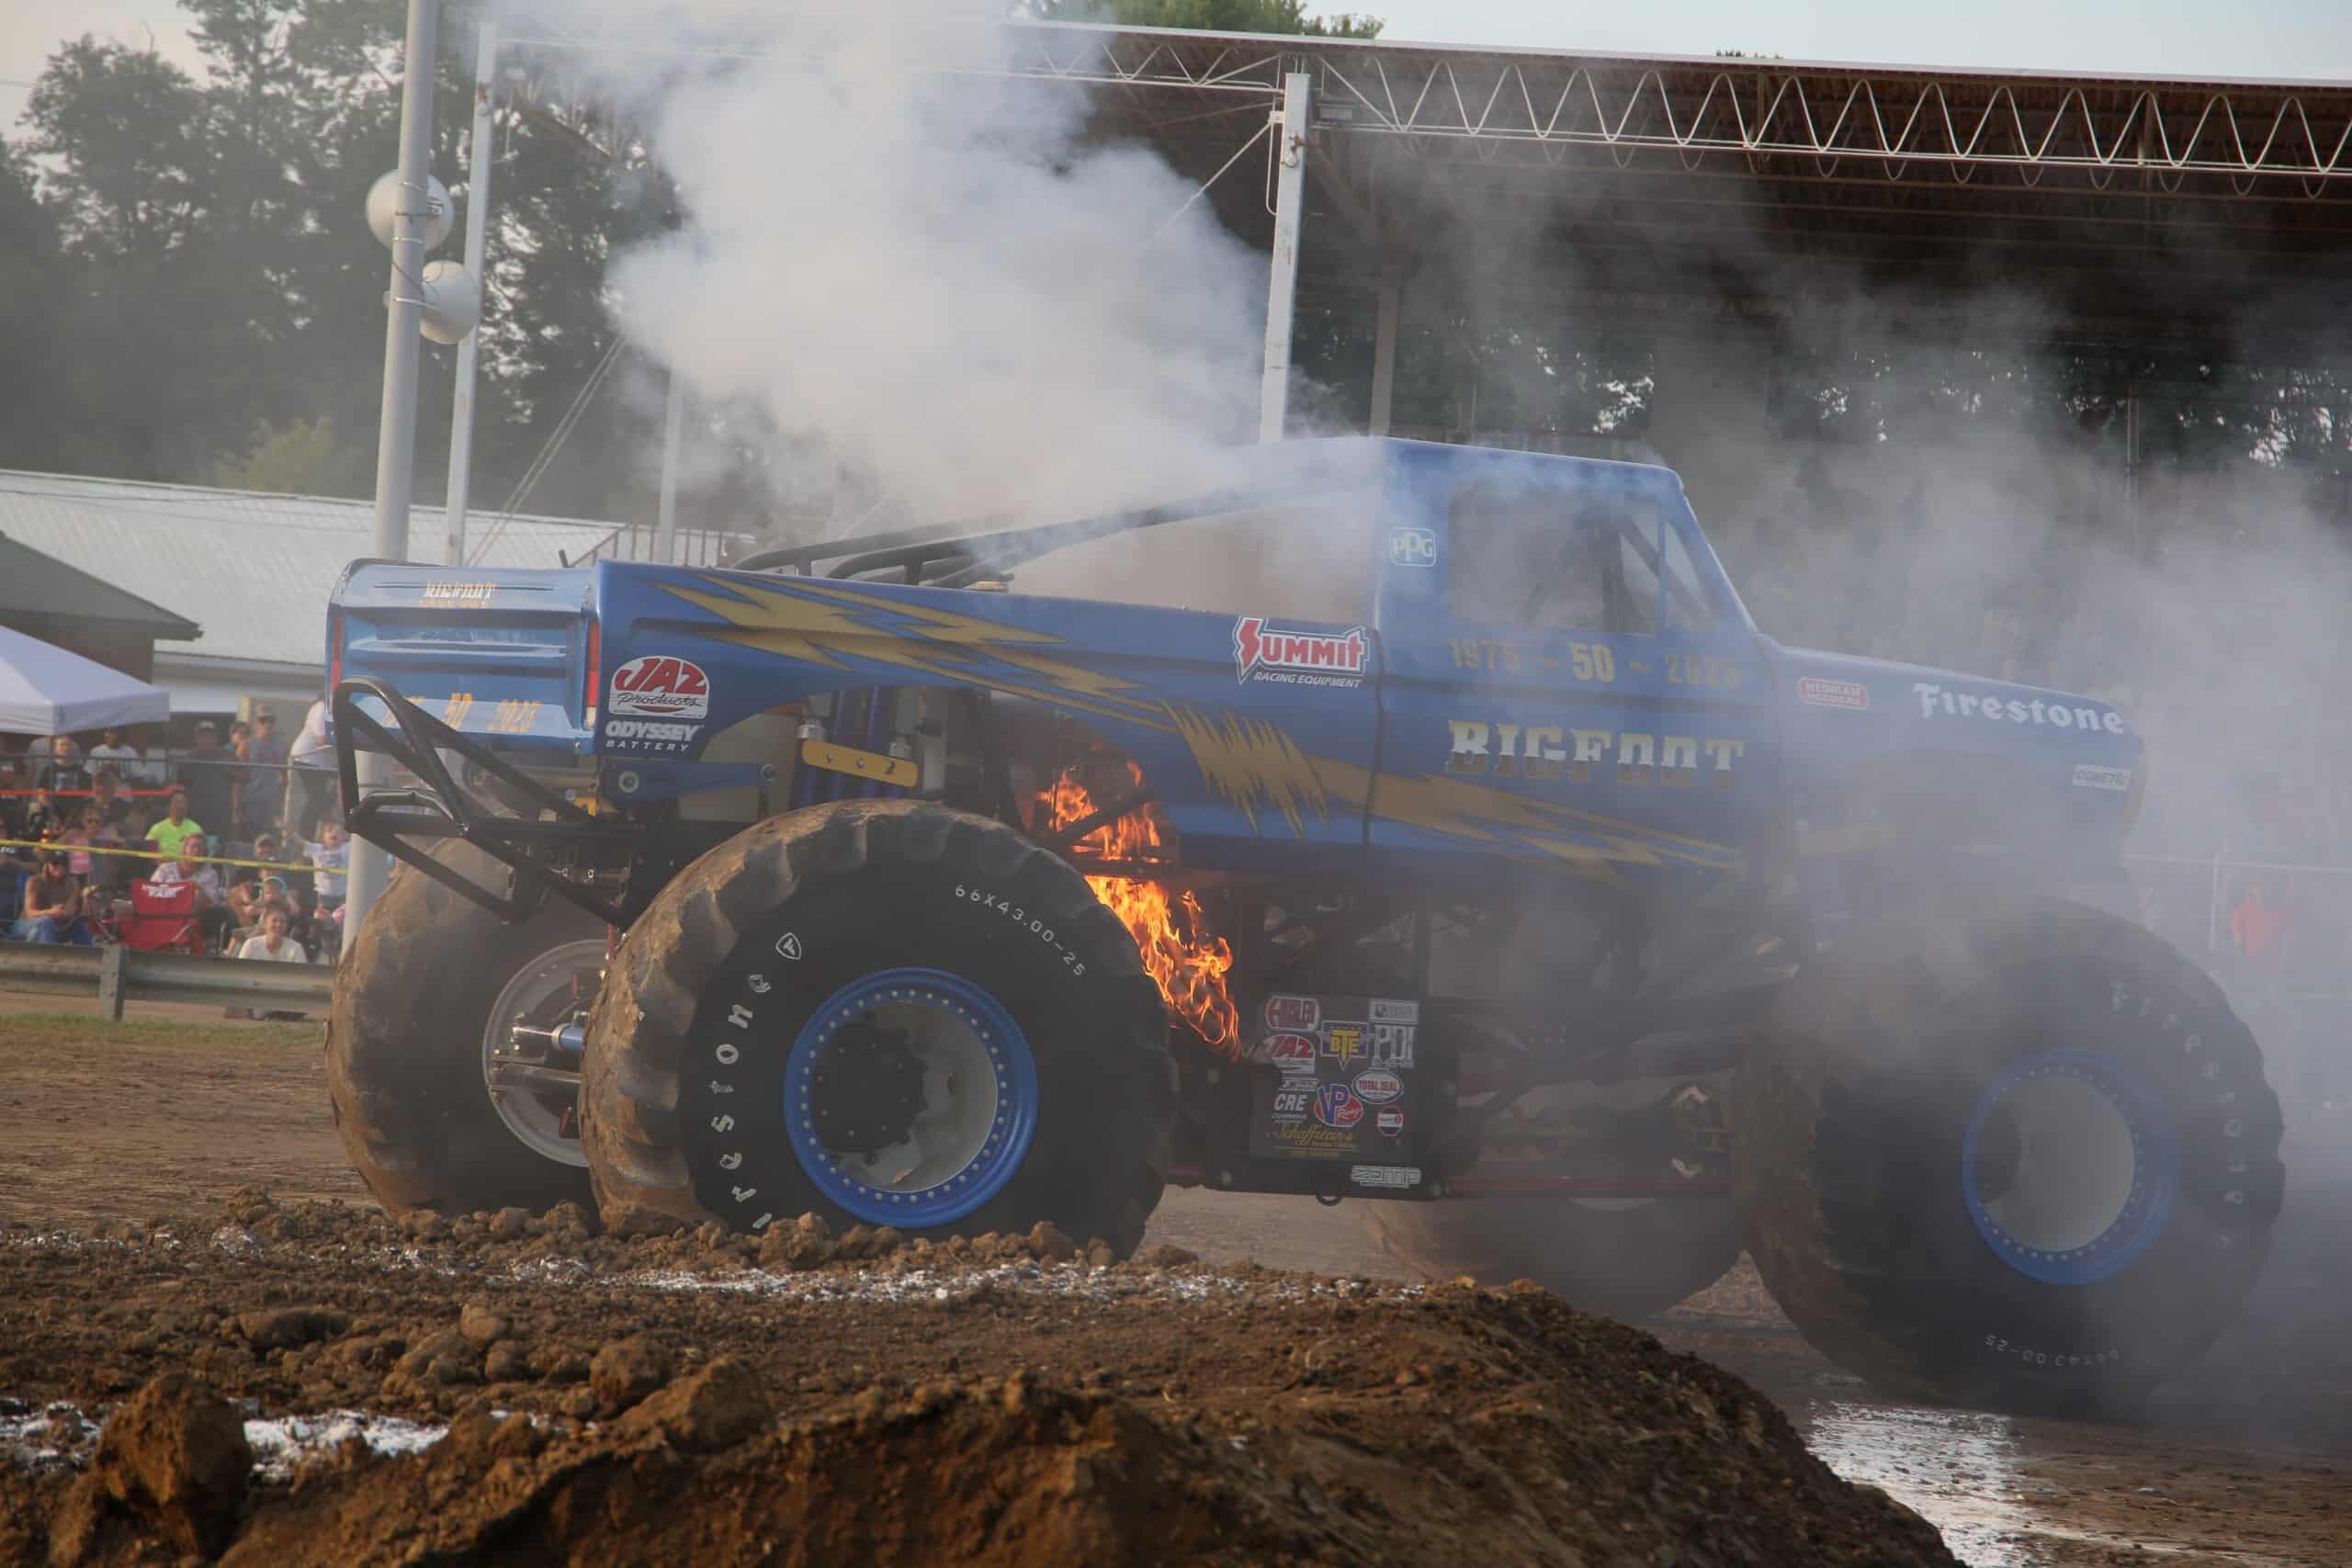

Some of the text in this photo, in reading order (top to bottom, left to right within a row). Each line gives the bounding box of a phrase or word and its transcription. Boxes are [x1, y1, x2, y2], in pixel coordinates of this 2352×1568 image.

[1393, 533, 1433, 561] PPG
[614, 658, 706, 694] JAZ
[1569, 641, 1615, 682] 50
[1253, 672, 1362, 689] RACING EQUIPMENT
[1912, 682, 2126, 735] Firestone
[605, 720, 704, 741] ODYSSEY
[605, 739, 689, 751] BATTERY
[1446, 719, 1744, 792] BIGFOOT
[1330, 1028, 1360, 1061] BTE
[1274, 1093, 1308, 1111] CRE
[1317, 1084, 1350, 1125] VP
